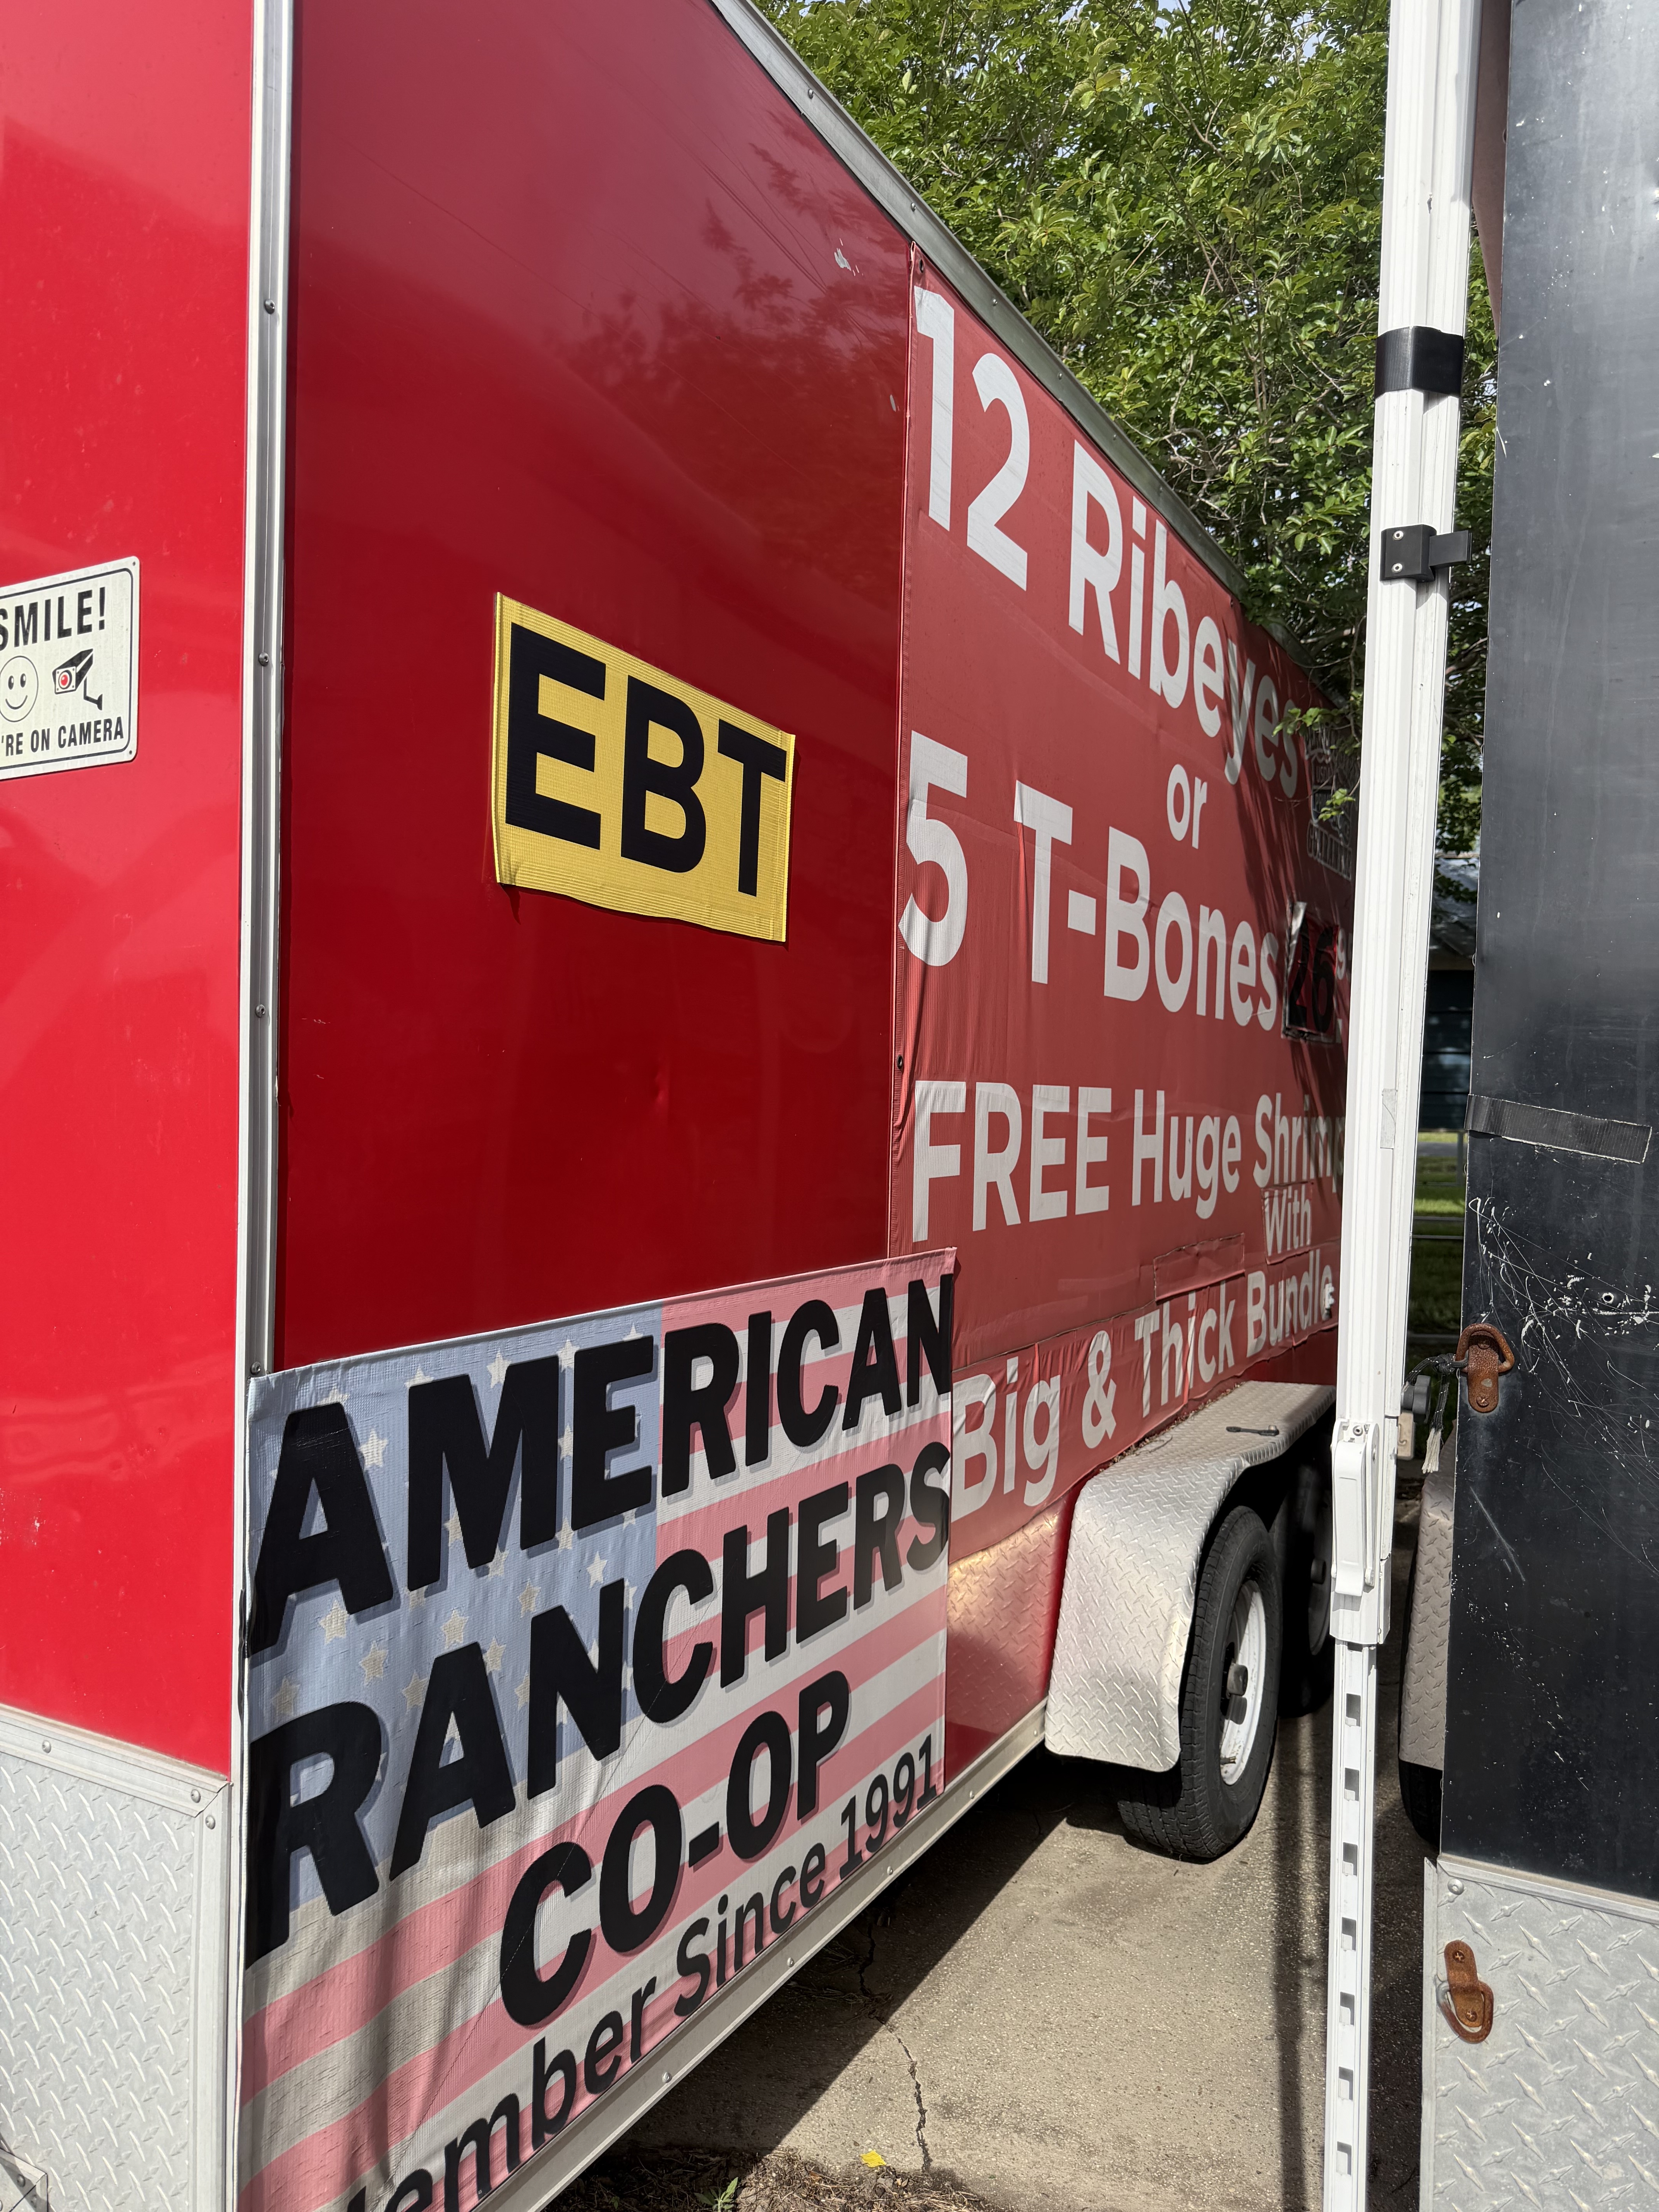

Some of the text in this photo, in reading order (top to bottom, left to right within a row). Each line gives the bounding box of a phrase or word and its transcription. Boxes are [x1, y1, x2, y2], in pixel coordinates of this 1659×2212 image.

[914, 286, 1298, 799] 12 Ribeyes
[31, 728, 50, 753] ON
[58, 716, 124, 748] CAMERA
[505, 622, 787, 897] EBT
[1166, 764, 1207, 849] or
[898, 730, 968, 967] 5
[1013, 780, 1278, 1031] T-Bones
[912, 1080, 1345, 1243] FREE Huge Shrimp
[1264, 1183, 1312, 1257] With
[247, 1273, 954, 1659] AMERICAN
[951, 1358, 1061, 1523] Big
[1082, 1330, 1116, 1449] &
[1134, 1278, 1236, 1416] Thick
[245, 1441, 951, 1969] RANCHERS
[499, 1670, 850, 2027] CO-OP
[673, 1843, 826, 2018] Since
[838, 1736, 938, 1879] 1991
